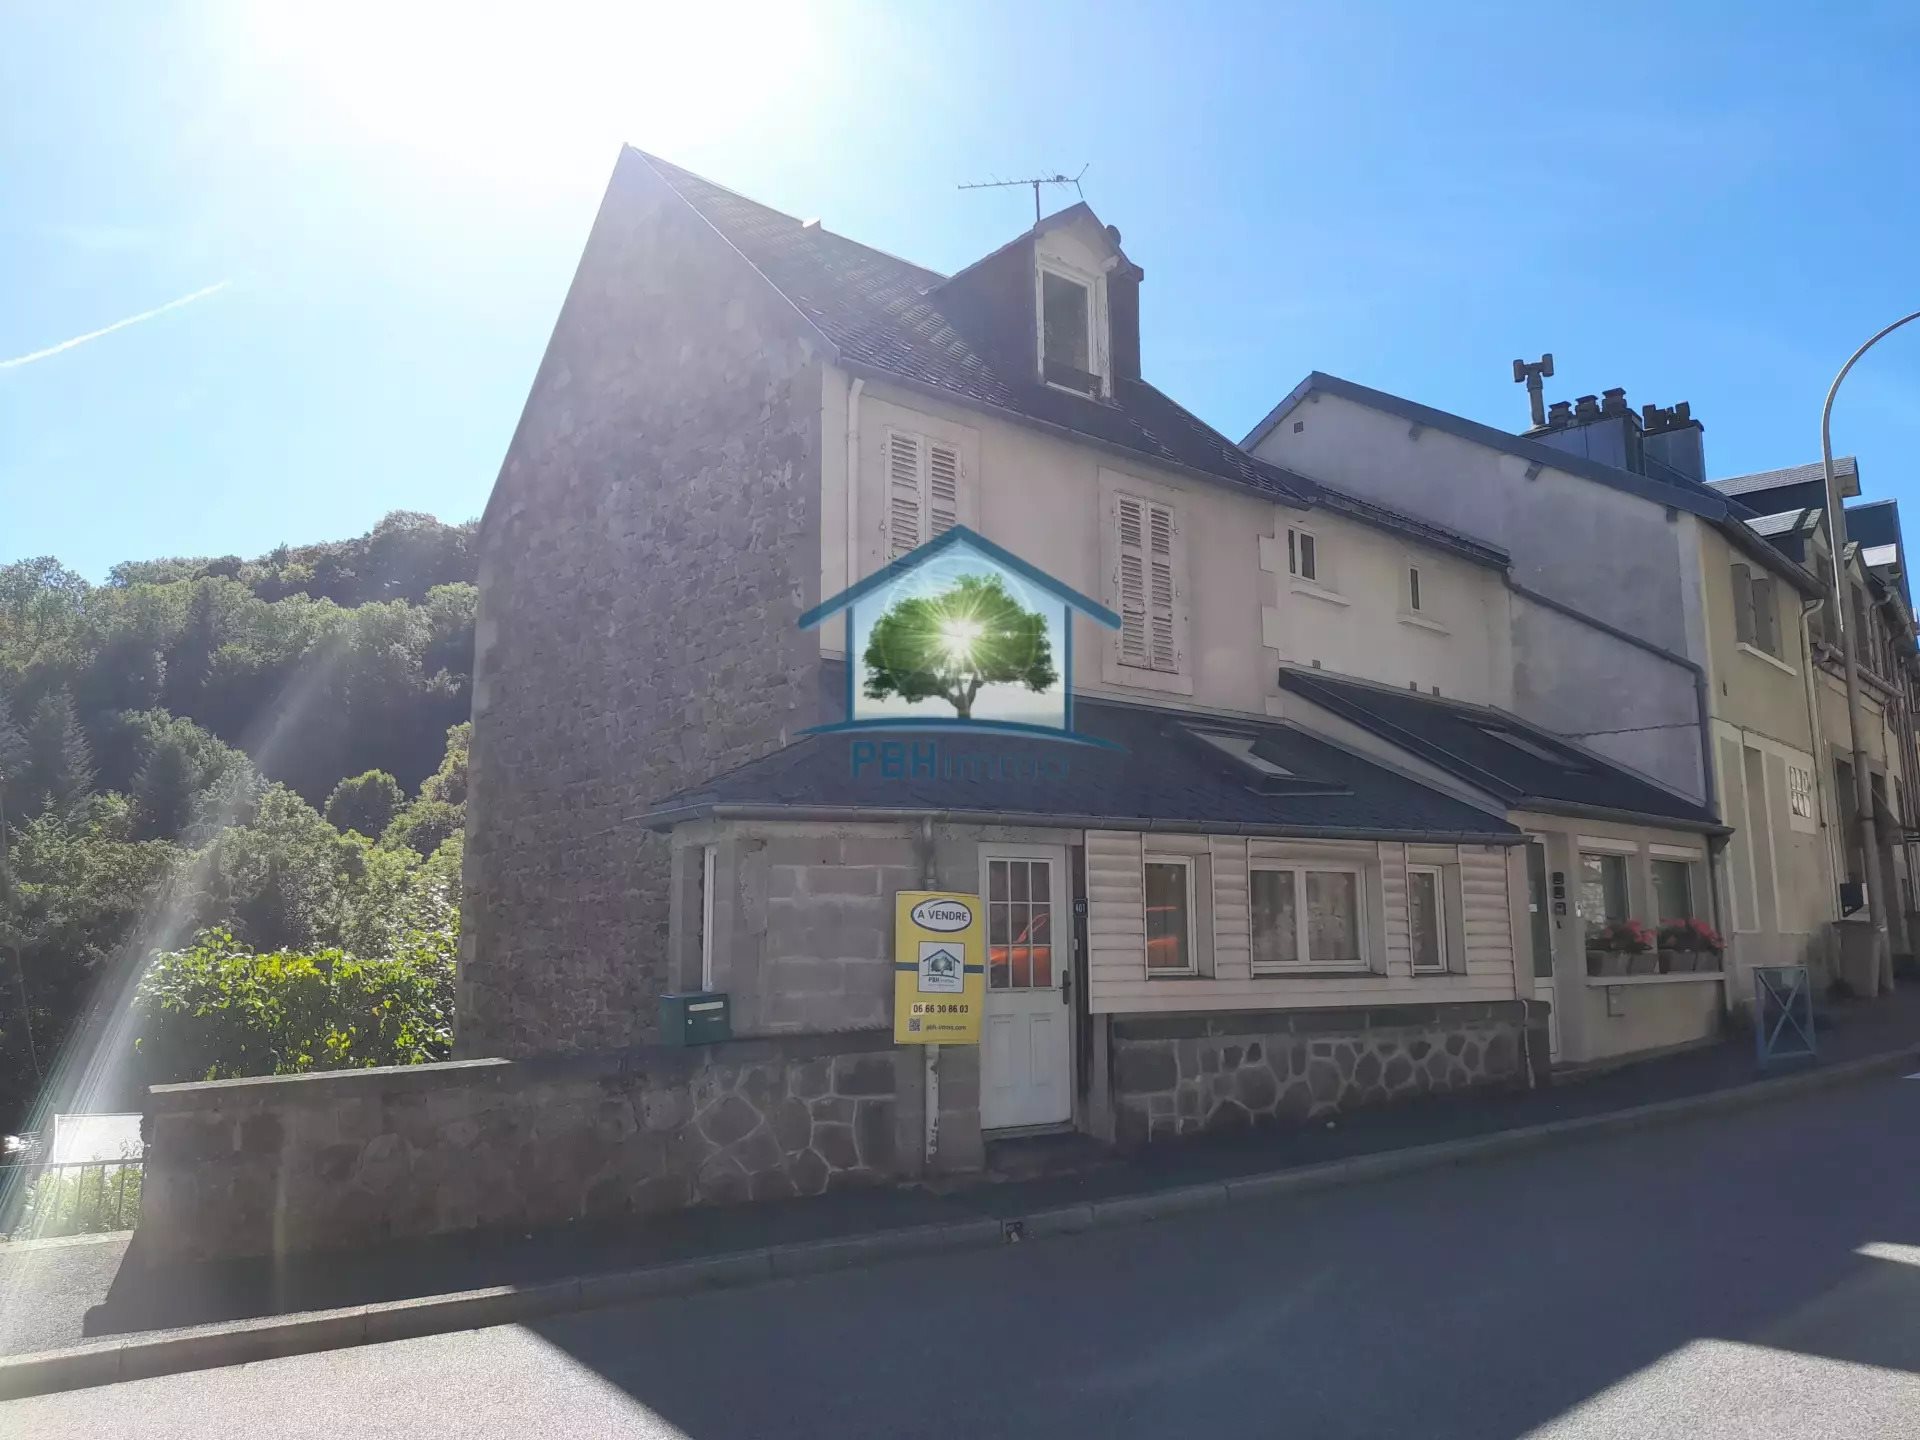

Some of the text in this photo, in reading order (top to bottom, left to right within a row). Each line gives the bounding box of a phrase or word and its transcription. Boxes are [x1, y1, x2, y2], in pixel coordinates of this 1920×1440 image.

[917, 909, 968, 922] A VENDRE
[913, 1004, 923, 1014] 06
[937, 1004, 947, 1014] 30
[959, 1004, 969, 1014] 03
